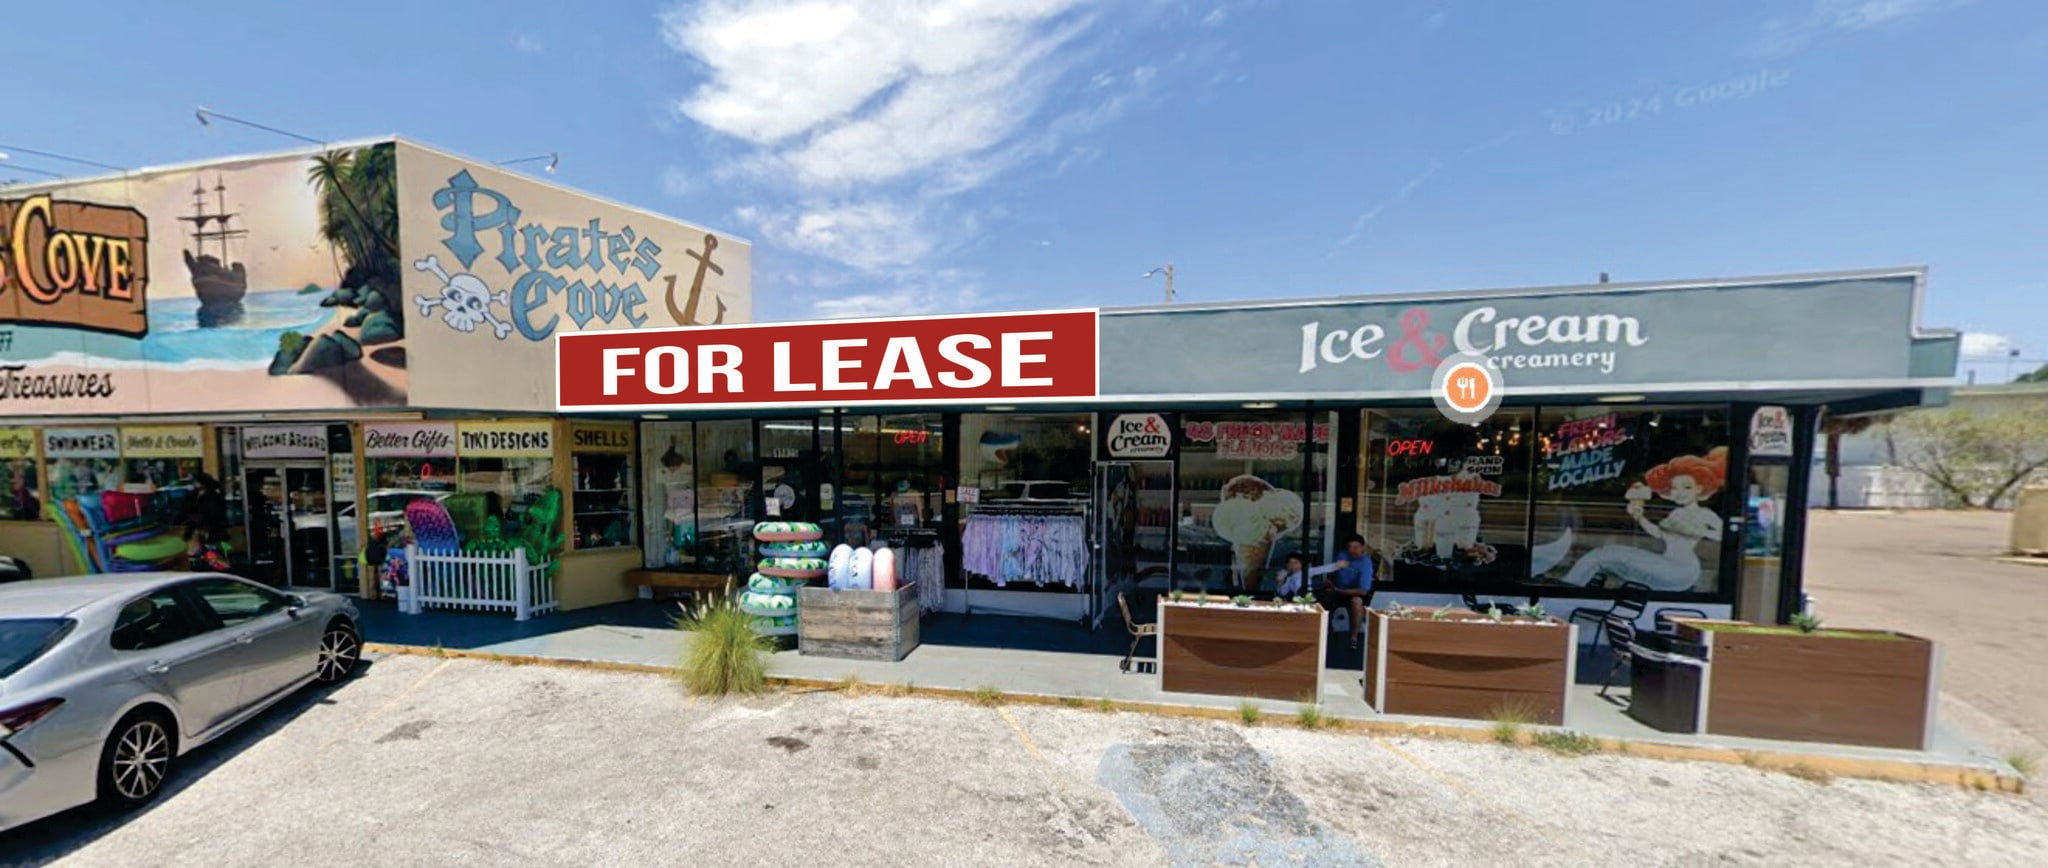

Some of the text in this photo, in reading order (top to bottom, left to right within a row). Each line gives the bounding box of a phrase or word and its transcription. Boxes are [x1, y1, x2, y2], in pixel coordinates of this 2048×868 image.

[432, 168, 662, 281] Pirate's
[510, 270, 649, 342] Cove
[1299, 306, 1649, 374] Ice & Cream
[1486, 349, 1615, 373] creamery
[1120, 416, 1160, 434] Ice &
[246, 431, 326, 451] WELCOME ABOARD
[366, 428, 453, 454] Better Gifts
[462, 431, 549, 449] TIKI DESIGNS
[575, 430, 629, 446] SHELLS
[894, 430, 927, 444] OPEN
[1111, 434, 1168, 452] Cream
[1389, 440, 1433, 456] OPEN
[1560, 446, 1614, 471] MADE
[1548, 460, 1626, 490] LOCALLY
